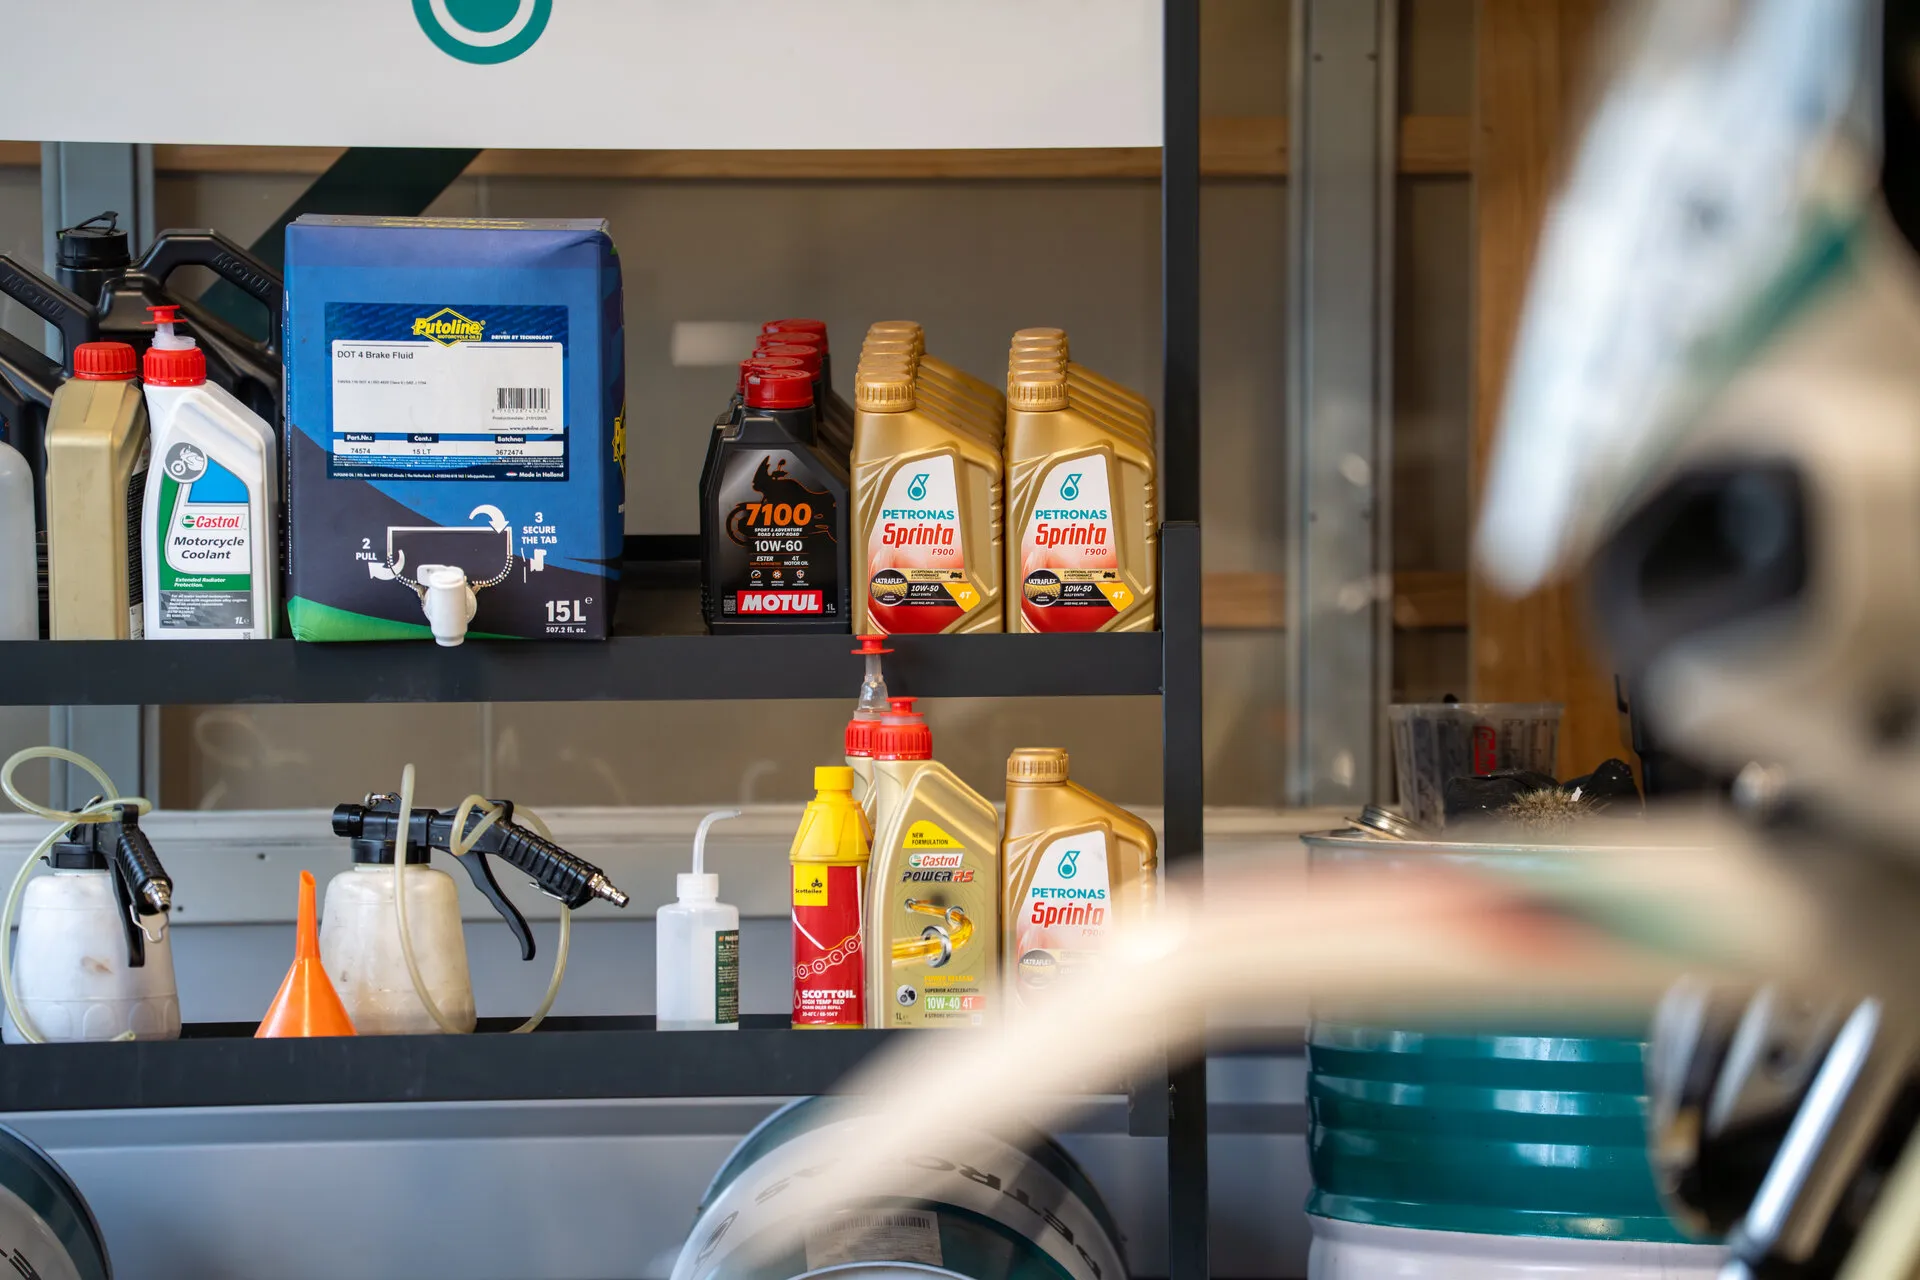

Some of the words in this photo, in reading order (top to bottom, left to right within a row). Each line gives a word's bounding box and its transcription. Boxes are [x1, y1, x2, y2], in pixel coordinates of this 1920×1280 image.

[415, 318, 481, 336] Putoline
[337, 351, 356, 359] DOT
[358, 351, 364, 359] 4
[365, 351, 391, 359] Brake
[392, 351, 414, 360] Fluid
[534, 512, 543, 523] 3
[746, 503, 812, 526] 7100
[882, 509, 955, 520] PETRONAS
[1035, 509, 1107, 520] PETRONAS
[195, 515, 240, 529] Castrol
[522, 526, 556, 534] SECURE
[882, 523, 954, 548] Sprinta
[1035, 523, 1107, 548] Sprinta
[173, 536, 245, 547] Motorcycle
[361, 538, 371, 549] 2
[521, 536, 538, 544] THE
[540, 536, 558, 544] TAB
[754, 540, 803, 552] 10W-60
[181, 550, 231, 560] Coolant
[355, 552, 378, 561] PULL
[931, 548, 955, 556] F900
[1084, 548, 1107, 556] F900
[959, 591, 972, 599] 4T
[1112, 591, 1125, 599] 4T
[741, 594, 819, 611] MOTUL
[826, 603, 836, 611] 1L
[235, 617, 244, 625] 1L
[922, 855, 960, 867] Castrol
[902, 870, 953, 882] POWER
[952, 869, 976, 882] RS
[1031, 887, 1106, 899] PETRONAS
[1031, 902, 1105, 928] Sprinta
[801, 989, 857, 999] SCOTTOIL
[927, 997, 960, 1009] 10W-40
[962, 997, 974, 1009] 4T
